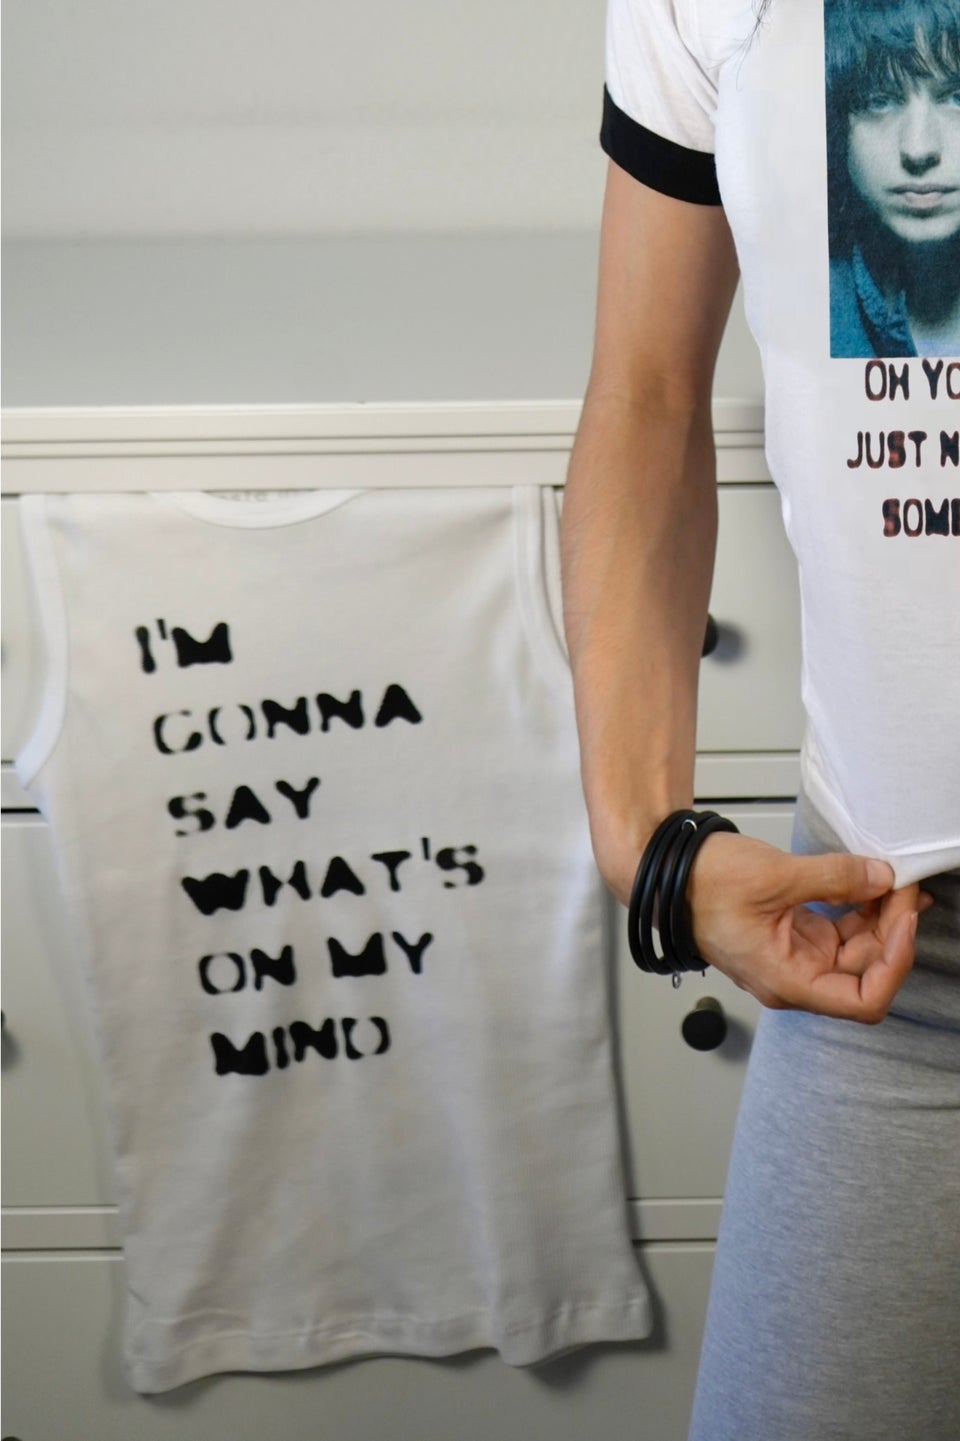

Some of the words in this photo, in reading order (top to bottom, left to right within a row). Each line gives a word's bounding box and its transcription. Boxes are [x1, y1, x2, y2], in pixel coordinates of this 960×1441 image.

[865, 360, 910, 401] OH
[846, 430, 927, 469] JUST
[135, 618, 233, 674] I'M
[153, 683, 423, 755] GONNA
[167, 776, 321, 837] SAY
[180, 836, 486, 917] WHAT'S
[198, 944, 298, 996] ON
[326, 931, 434, 980] MY
[210, 1015, 392, 1077] MIND
